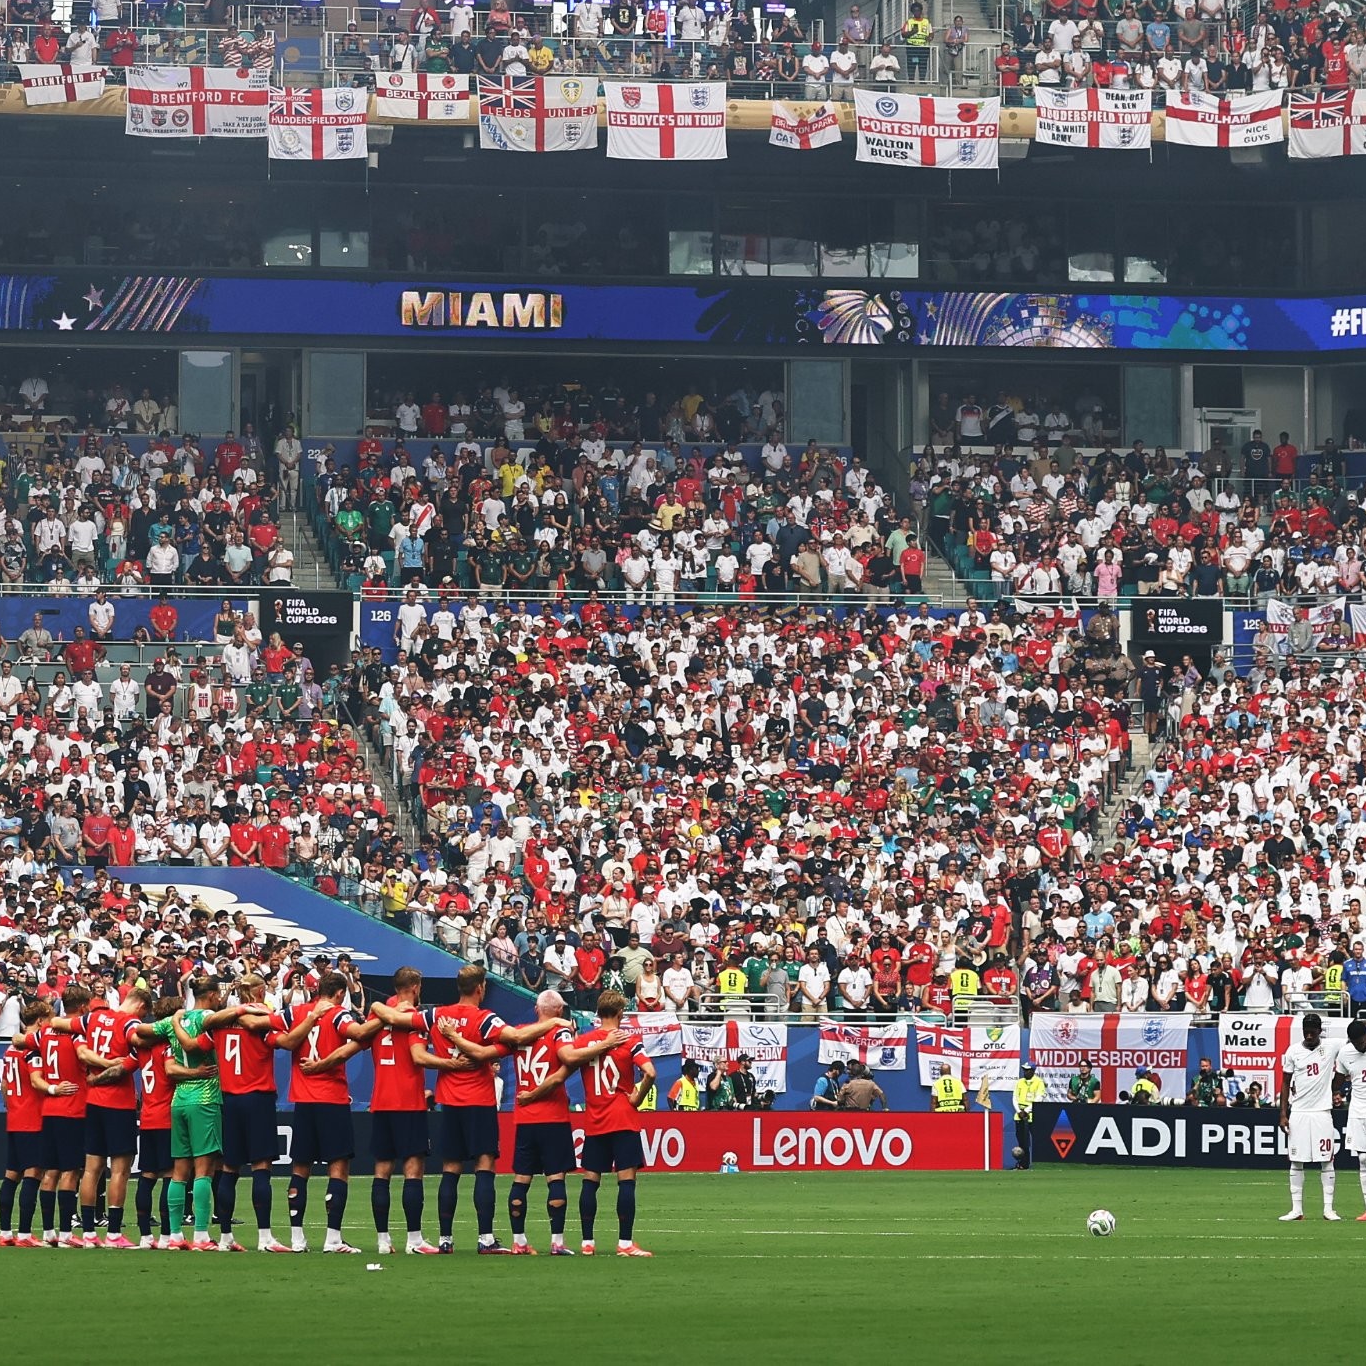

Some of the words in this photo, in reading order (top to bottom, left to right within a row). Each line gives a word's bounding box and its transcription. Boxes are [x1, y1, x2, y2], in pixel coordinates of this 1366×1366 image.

[32, 74, 84, 86] BRENTFORD
[153, 92, 222, 104] BRENTFORD
[230, 93, 244, 103] FC
[386, 90, 427, 99] BEXLEY
[430, 91, 459, 100] KENT
[489, 107, 531, 117] LEEDS
[548, 105, 596, 118] UNITED
[1040, 108, 1115, 122] HUDDERSFIELD
[1119, 113, 1147, 123] TOWN
[271, 115, 335, 125] HUDDERSFIELD
[337, 115, 362, 124] TOWN
[630, 115, 675, 126] BOYCE'S
[677, 115, 693, 125] ON
[695, 115, 722, 125] TOUR
[1197, 112, 1250, 124] FULHAM
[1313, 116, 1361, 128] FULHAM
[861, 120, 973, 138] PORTSMOUTH
[976, 124, 995, 137] FC
[1246, 124, 1267, 134] NICE
[865, 136, 914, 150] WALTON
[1244, 134, 1270, 143] GUYS
[871, 147, 908, 160] BLUES
[402, 292, 562, 327] MIAMI
[287, 599, 306, 607] FIFA
[287, 616, 304, 624] CUP
[306, 616, 337, 624] 2026
[371, 611, 391, 622] 126
[1158, 617, 1190, 625] WORLD
[1158, 625, 1177, 633] CUP
[1177, 625, 1207, 634] 2026
[1231, 1020, 1262, 1031] Our
[844, 1036, 885, 1046] EVERTON
[1225, 1034, 1267, 1047] Mate
[225, 1034, 240, 1075] 9
[942, 1049, 975, 1057] NORWICH
[1036, 1051, 1181, 1066] MIDDLESBROUGH
[47, 1041, 59, 1079] 5
[1223, 1054, 1277, 1069] Jimmy
[1307, 1063, 1319, 1076] 20
[588, 1056, 620, 1096] 10
[753, 1118, 912, 1166] Lenovo
[1085, 1117, 1186, 1157] ADI
